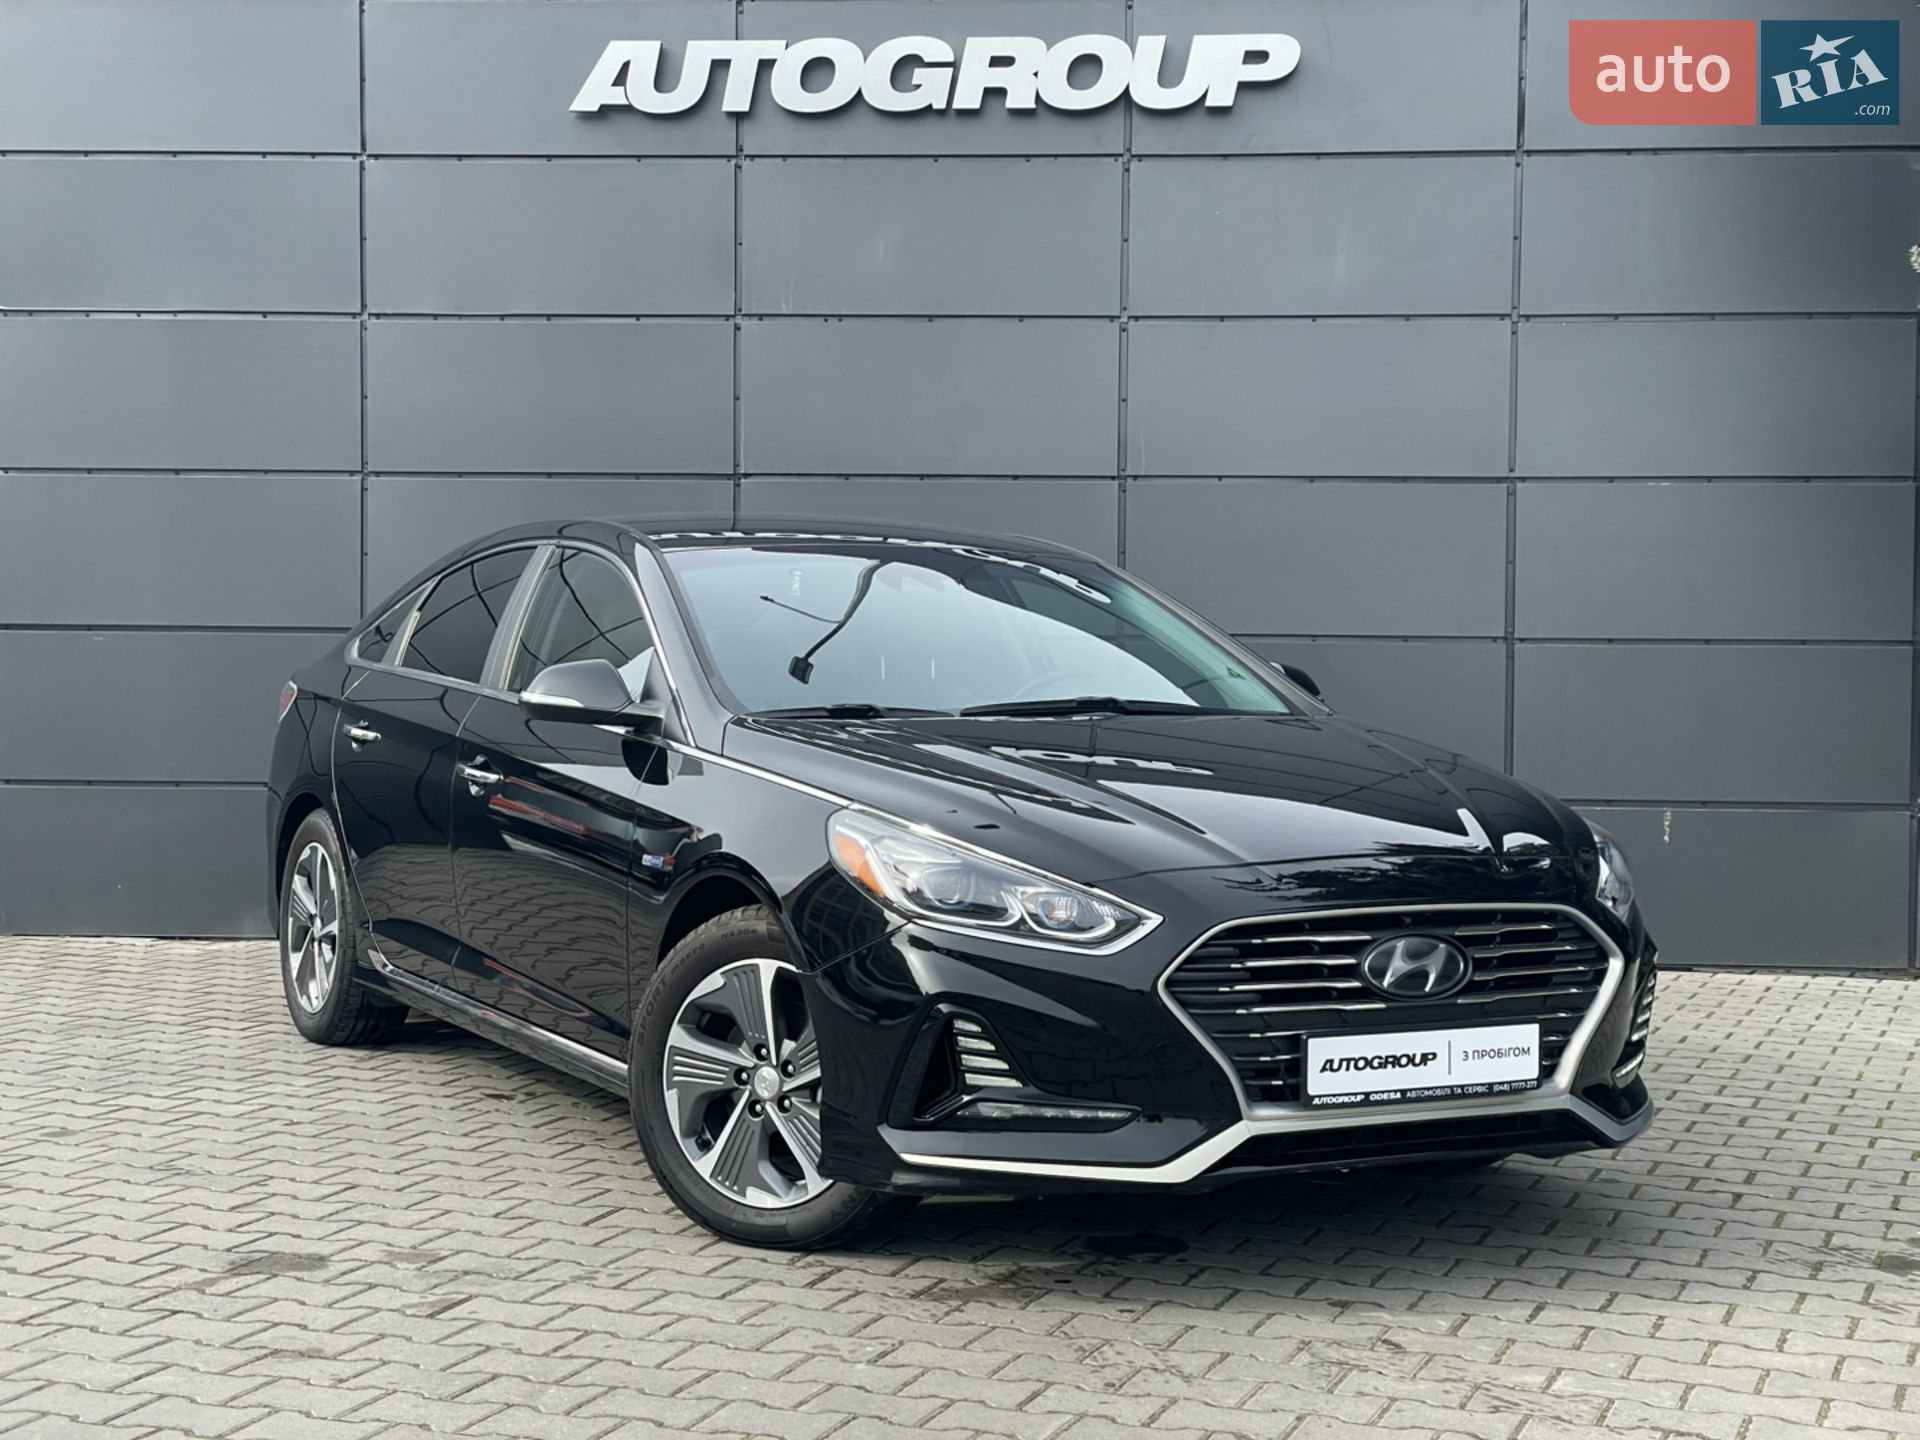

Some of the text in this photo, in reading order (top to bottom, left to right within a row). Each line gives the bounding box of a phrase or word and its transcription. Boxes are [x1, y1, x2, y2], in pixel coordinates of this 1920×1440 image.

[569, 33, 1301, 115] AUTOGROUP
[637, 975, 668, 1046] SPORT
[1319, 1051, 1438, 1073] AUTOGROUP
[1472, 1046, 1531, 1060] ПРОБІГОМ
[1311, 1094, 1365, 1105] AUTOGROUP
[1369, 1091, 1401, 1101] ODESA
